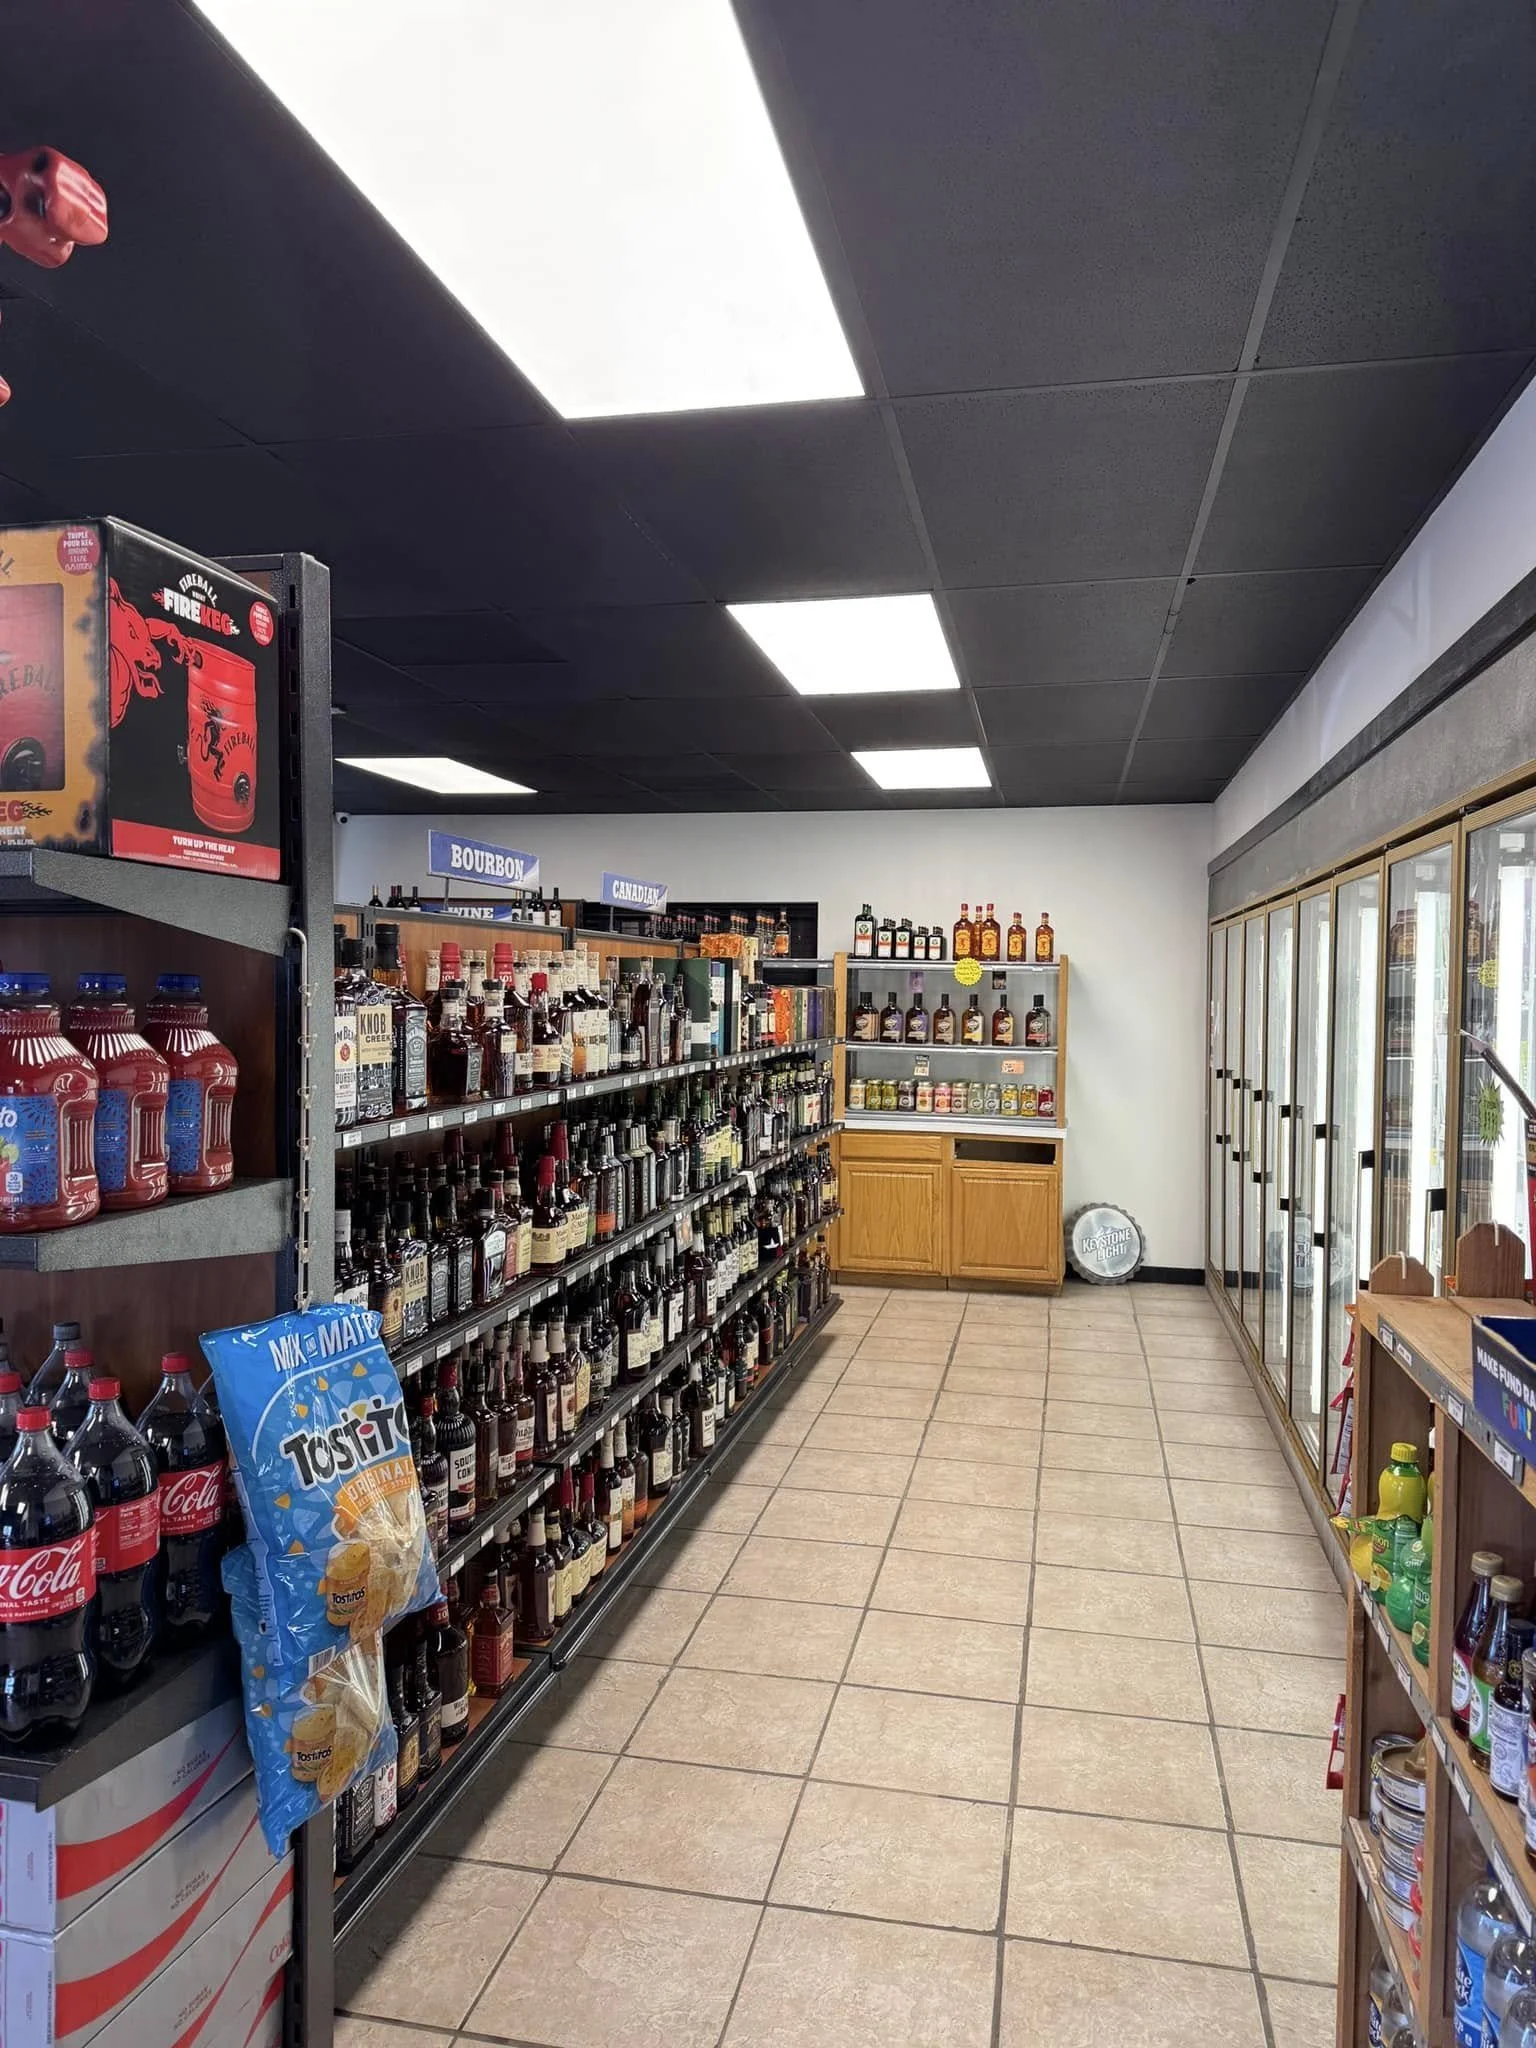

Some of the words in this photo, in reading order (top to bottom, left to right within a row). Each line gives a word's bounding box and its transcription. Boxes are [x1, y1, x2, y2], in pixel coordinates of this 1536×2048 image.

[178, 573, 218, 608] FIREBALL
[163, 587, 232, 635] FIREKEG
[172, 835, 193, 847] TURN
[193, 840, 204, 848] UP
[204, 841, 218, 851] THE
[218, 844, 235, 854] HEAT
[451, 844, 524, 881] BOURBON
[612, 880, 661, 904] CANADIAN
[448, 907, 494, 920] WINE
[360, 1013, 386, 1036] KNOB
[366, 1035, 391, 1043] CREEK
[1082, 1227, 1132, 1254] KEYSTONE
[1097, 1243, 1127, 1262] LIGHT
[405, 1261, 424, 1282] KNOB
[268, 1333, 307, 1372] MIX
[1476, 1345, 1499, 1379] MAKE
[1499, 1364, 1522, 1398] FUND
[1502, 1391, 1532, 1440] FUN!
[22, 1597, 50, 1607] TASTE
